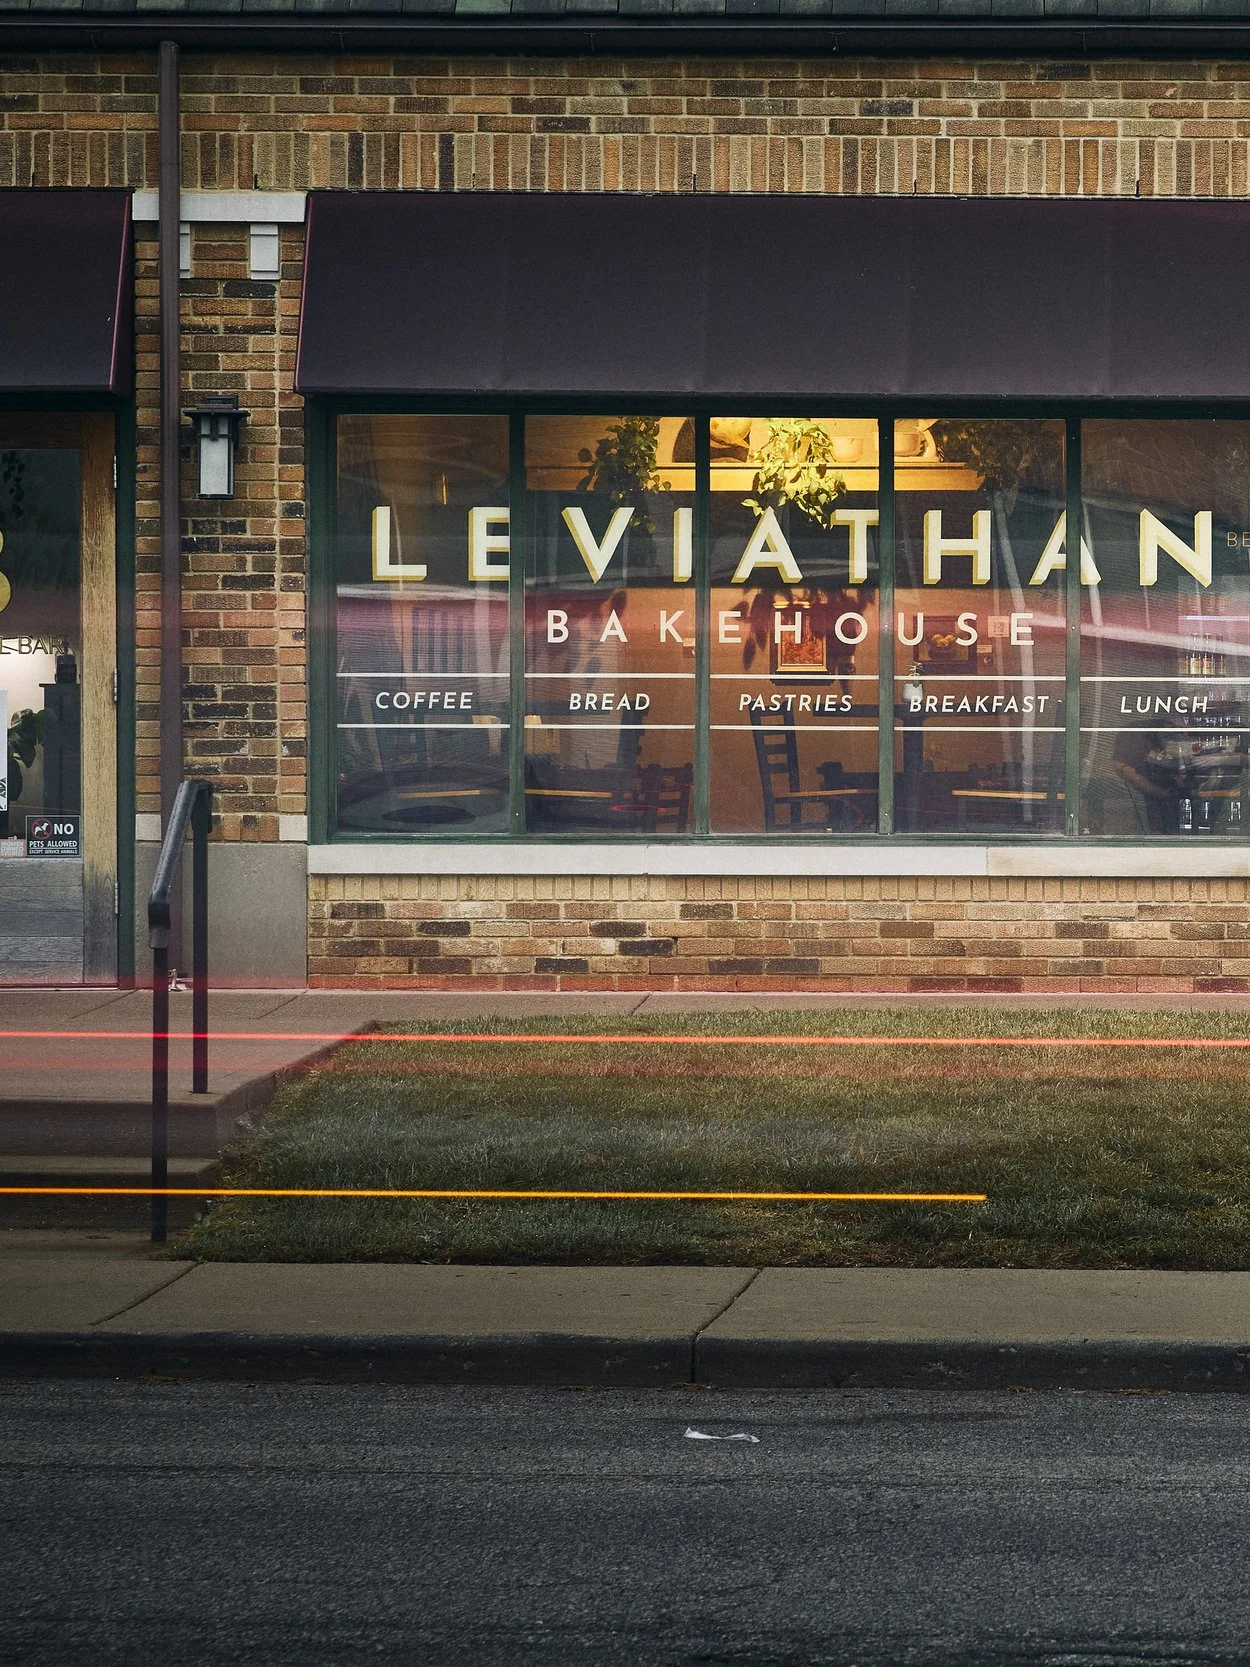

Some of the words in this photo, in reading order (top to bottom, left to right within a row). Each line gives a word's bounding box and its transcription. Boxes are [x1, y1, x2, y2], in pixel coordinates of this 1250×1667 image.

[372, 505, 1213, 588] LEVIATHAN
[547, 609, 1034, 646] BAKEHOUSE
[375, 691, 473, 710] COFFEE
[569, 692, 651, 711] BREAD
[739, 694, 853, 712] PASTRIES
[909, 695, 1049, 713] BREAKFAST
[1120, 696, 1208, 713] LUNCH
[54, 824, 74, 835] NO
